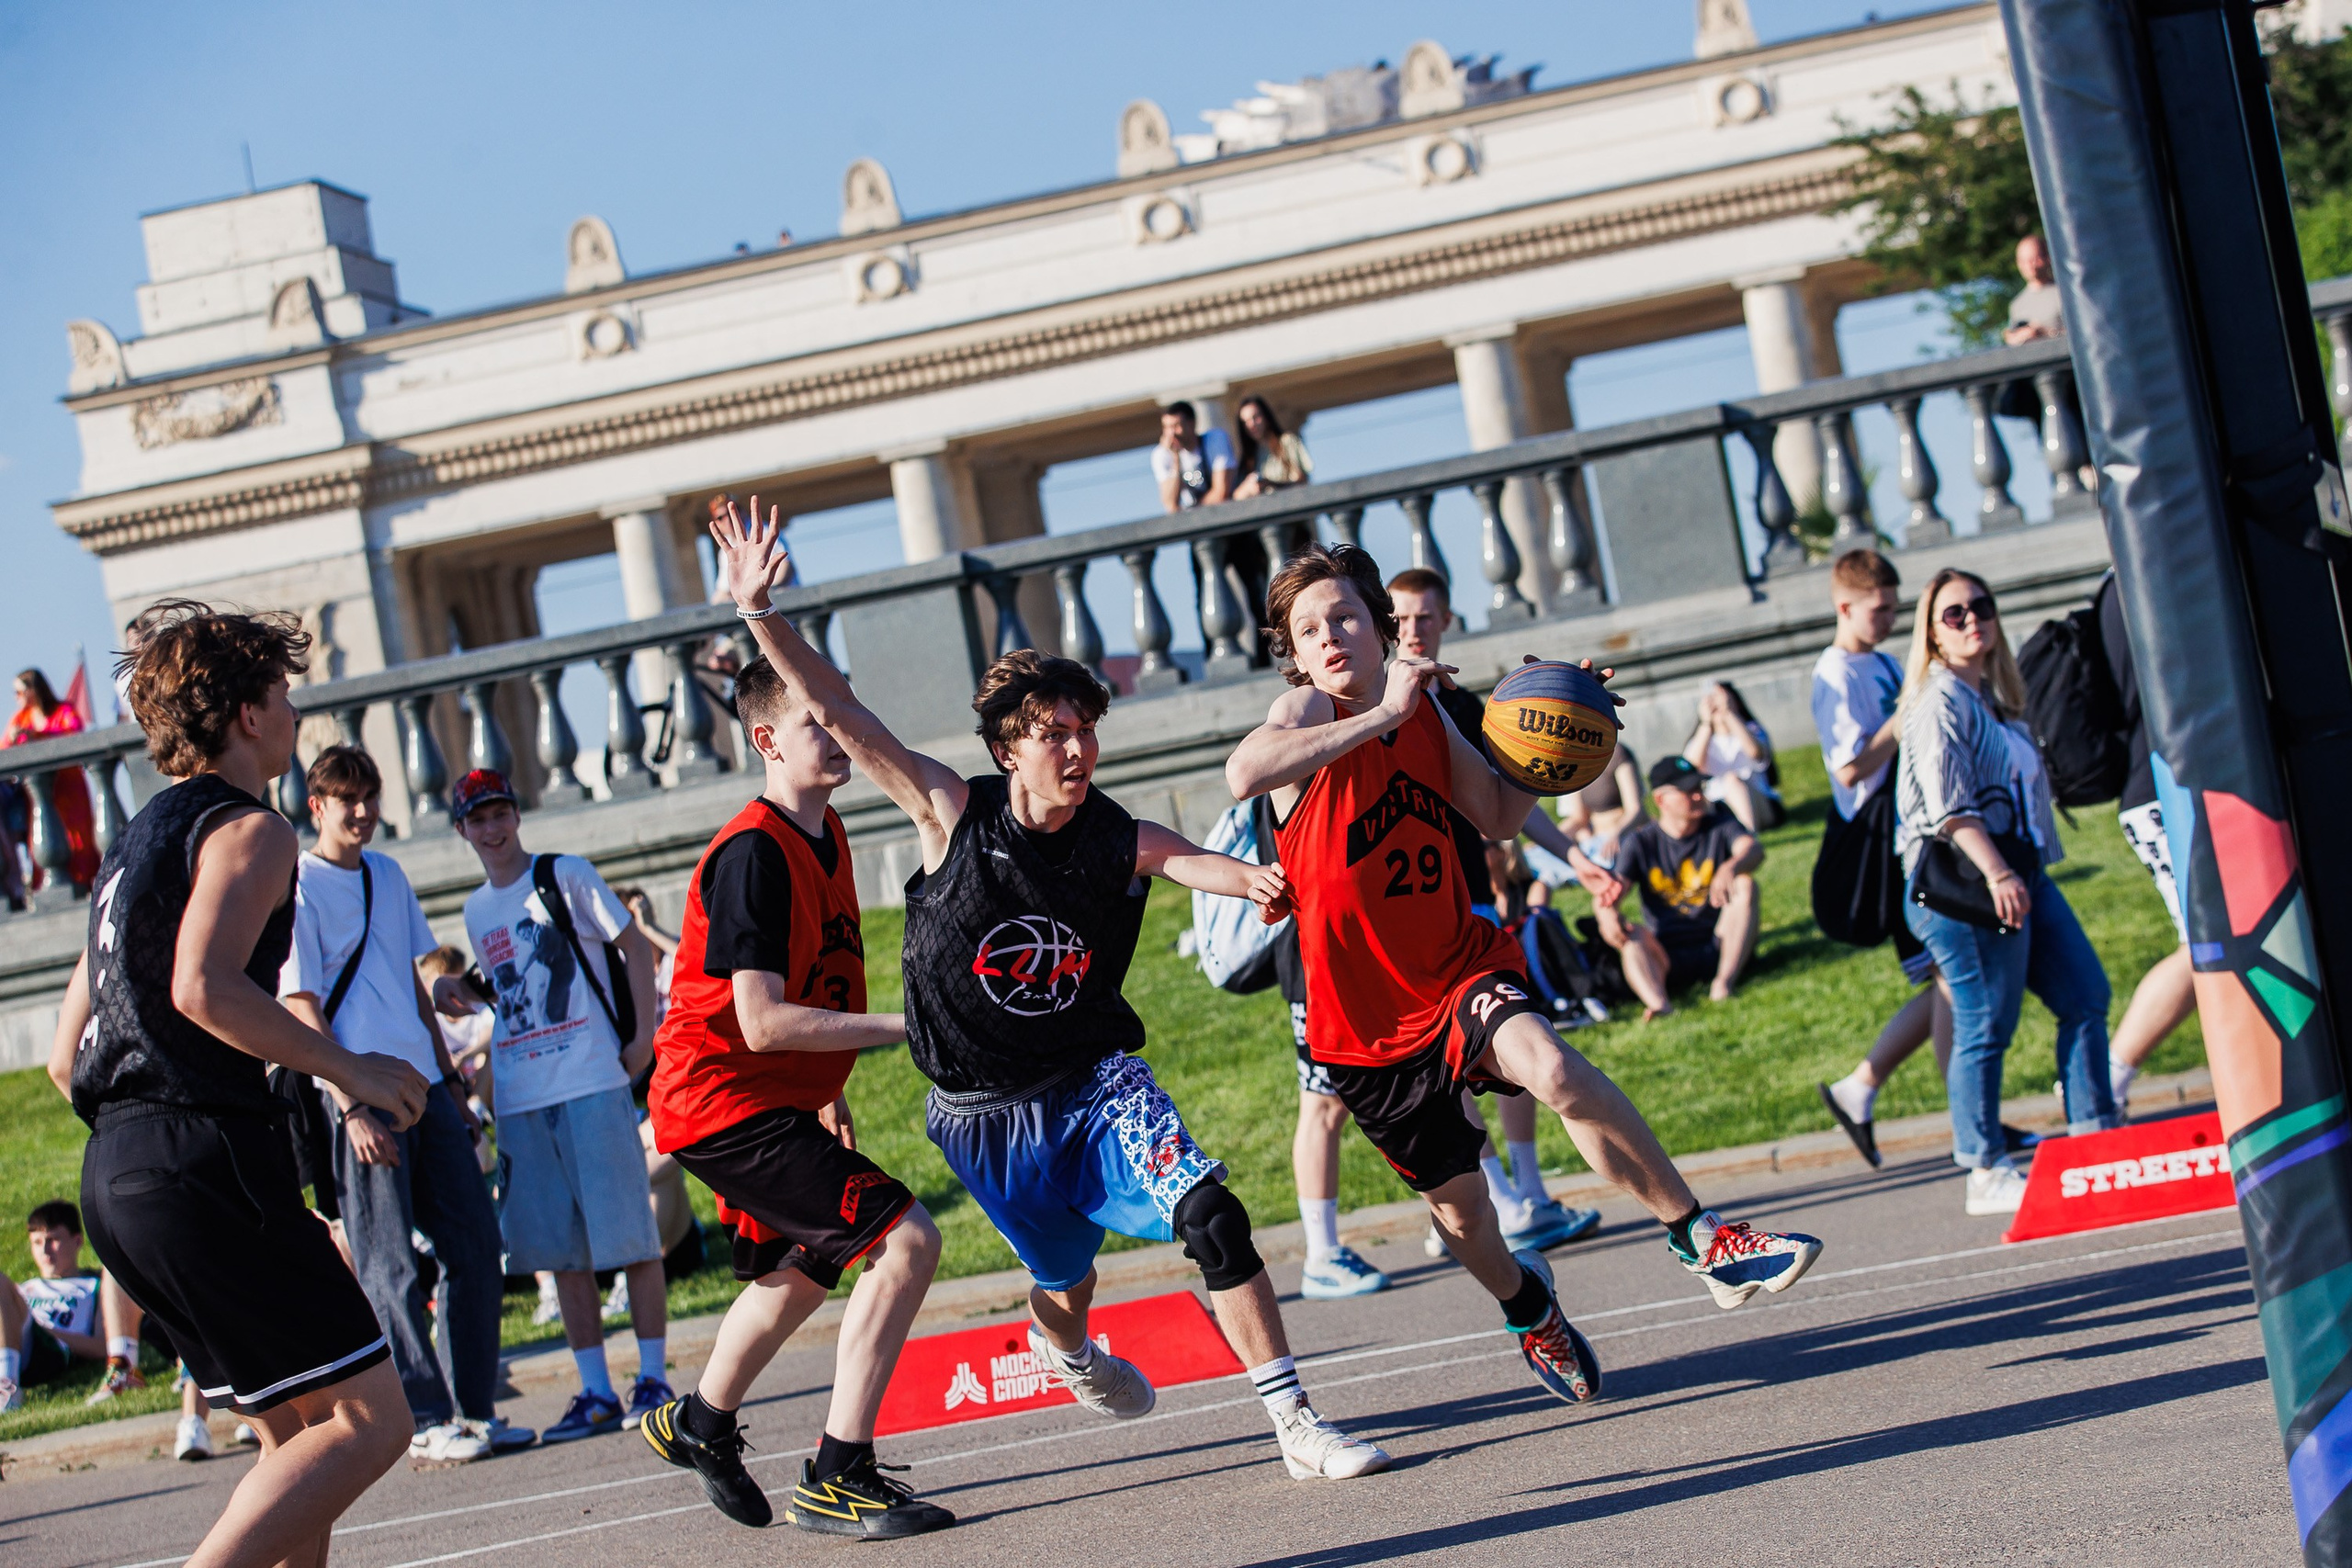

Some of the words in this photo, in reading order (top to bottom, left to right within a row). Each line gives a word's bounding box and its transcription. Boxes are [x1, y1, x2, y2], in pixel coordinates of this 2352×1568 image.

[1519, 707, 1603, 747] Wilson
[1384, 844, 1442, 900] 29
[1471, 983, 1529, 1027] 29
